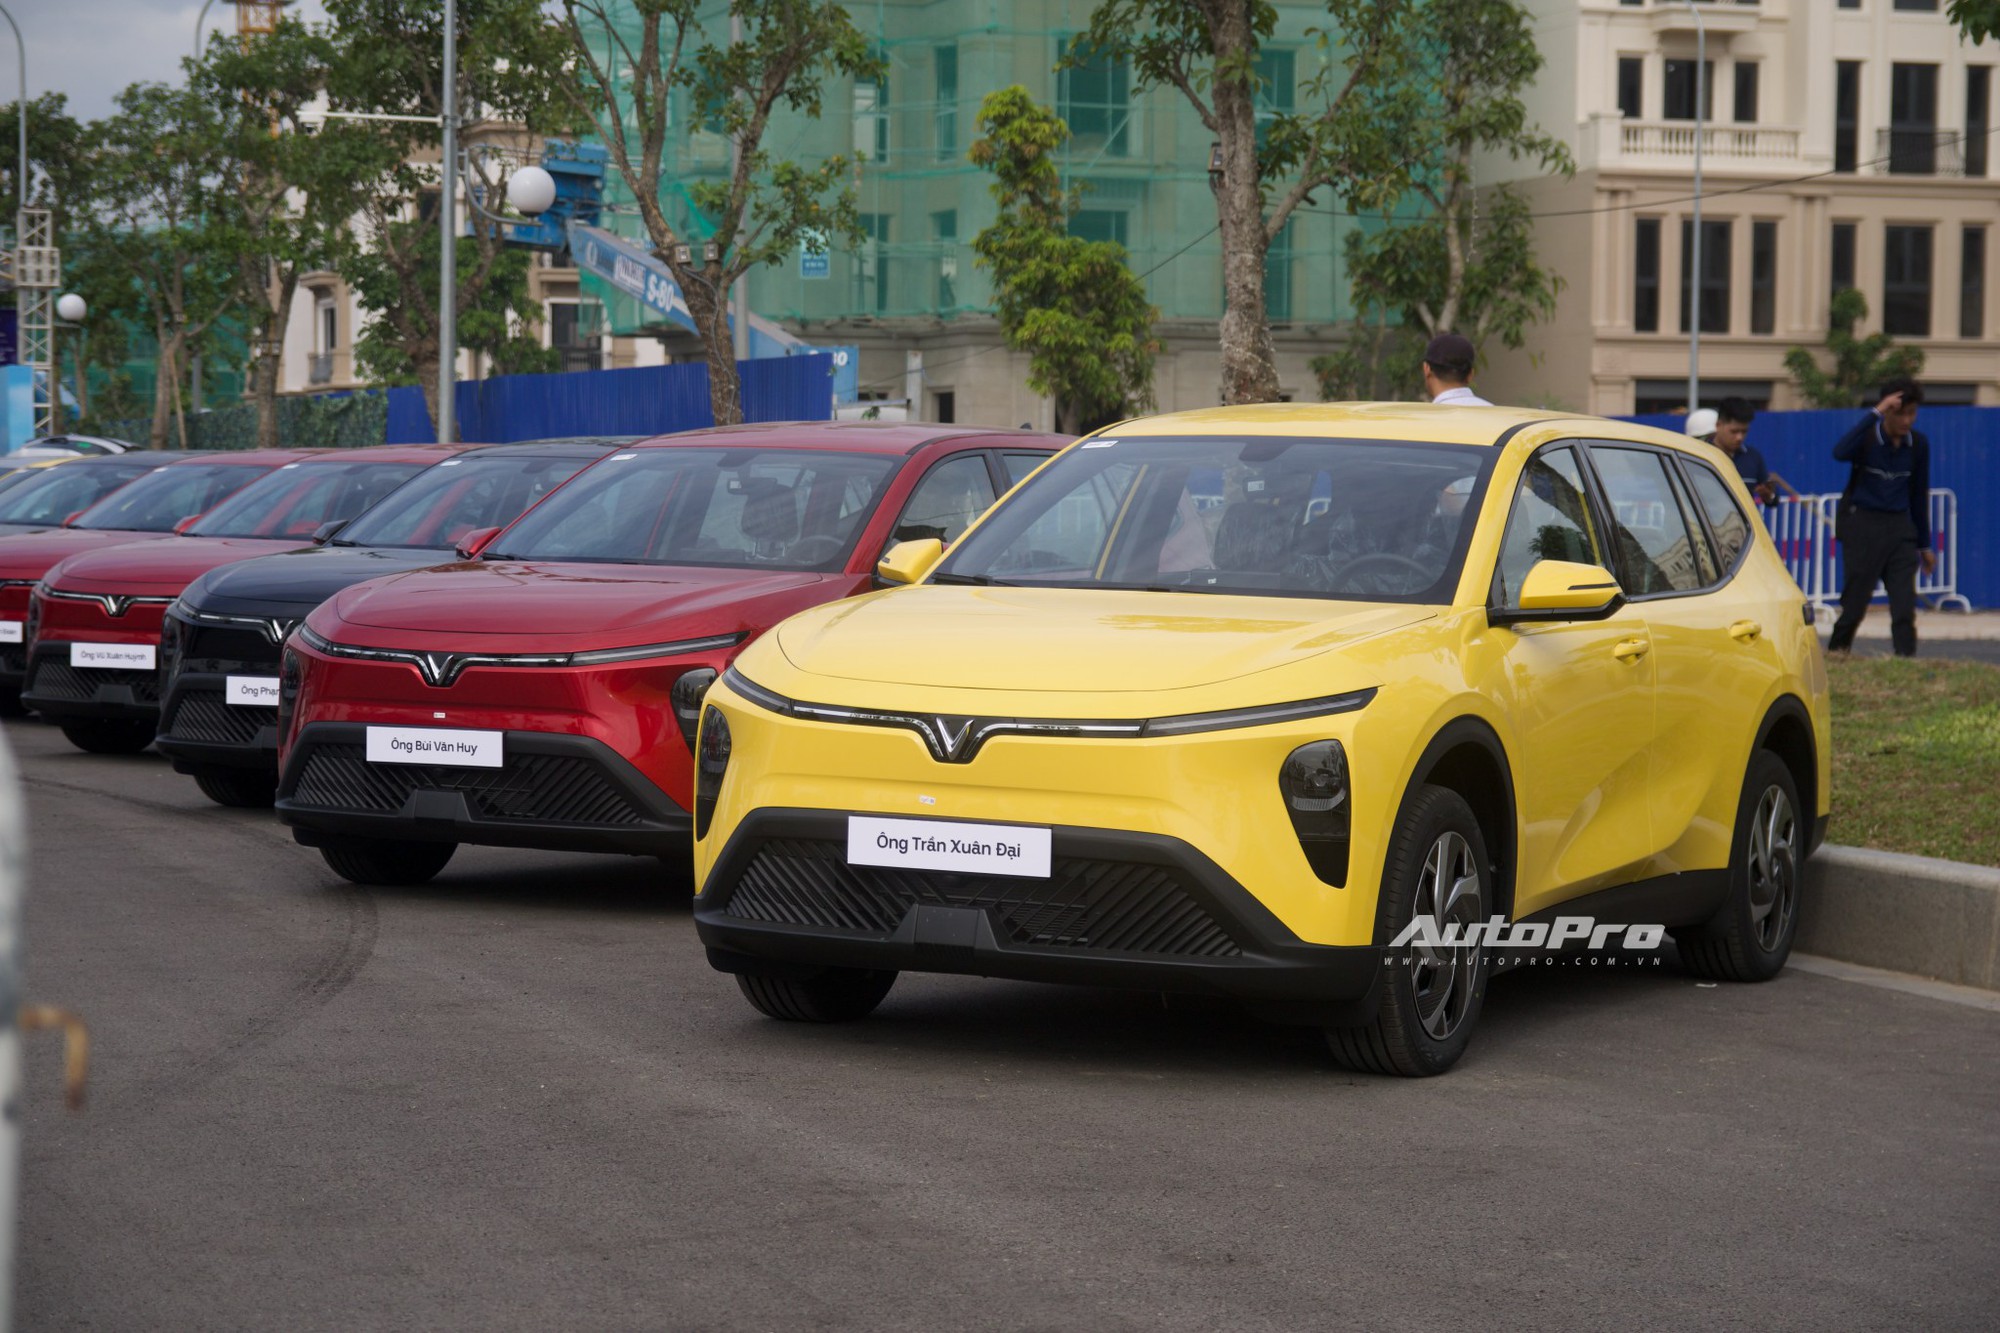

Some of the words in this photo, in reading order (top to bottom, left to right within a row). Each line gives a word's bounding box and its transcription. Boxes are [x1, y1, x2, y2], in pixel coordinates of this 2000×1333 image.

[241, 684, 259, 698] Ông
[391, 737, 413, 754] Ông
[415, 739, 432, 751] Bùi
[433, 741, 455, 752] Văn
[456, 742, 478, 756] Huy
[876, 831, 909, 855] Ông
[911, 836, 947, 853] Trần
[949, 839, 992, 856] Xuân
[995, 842, 1021, 860] Đại
